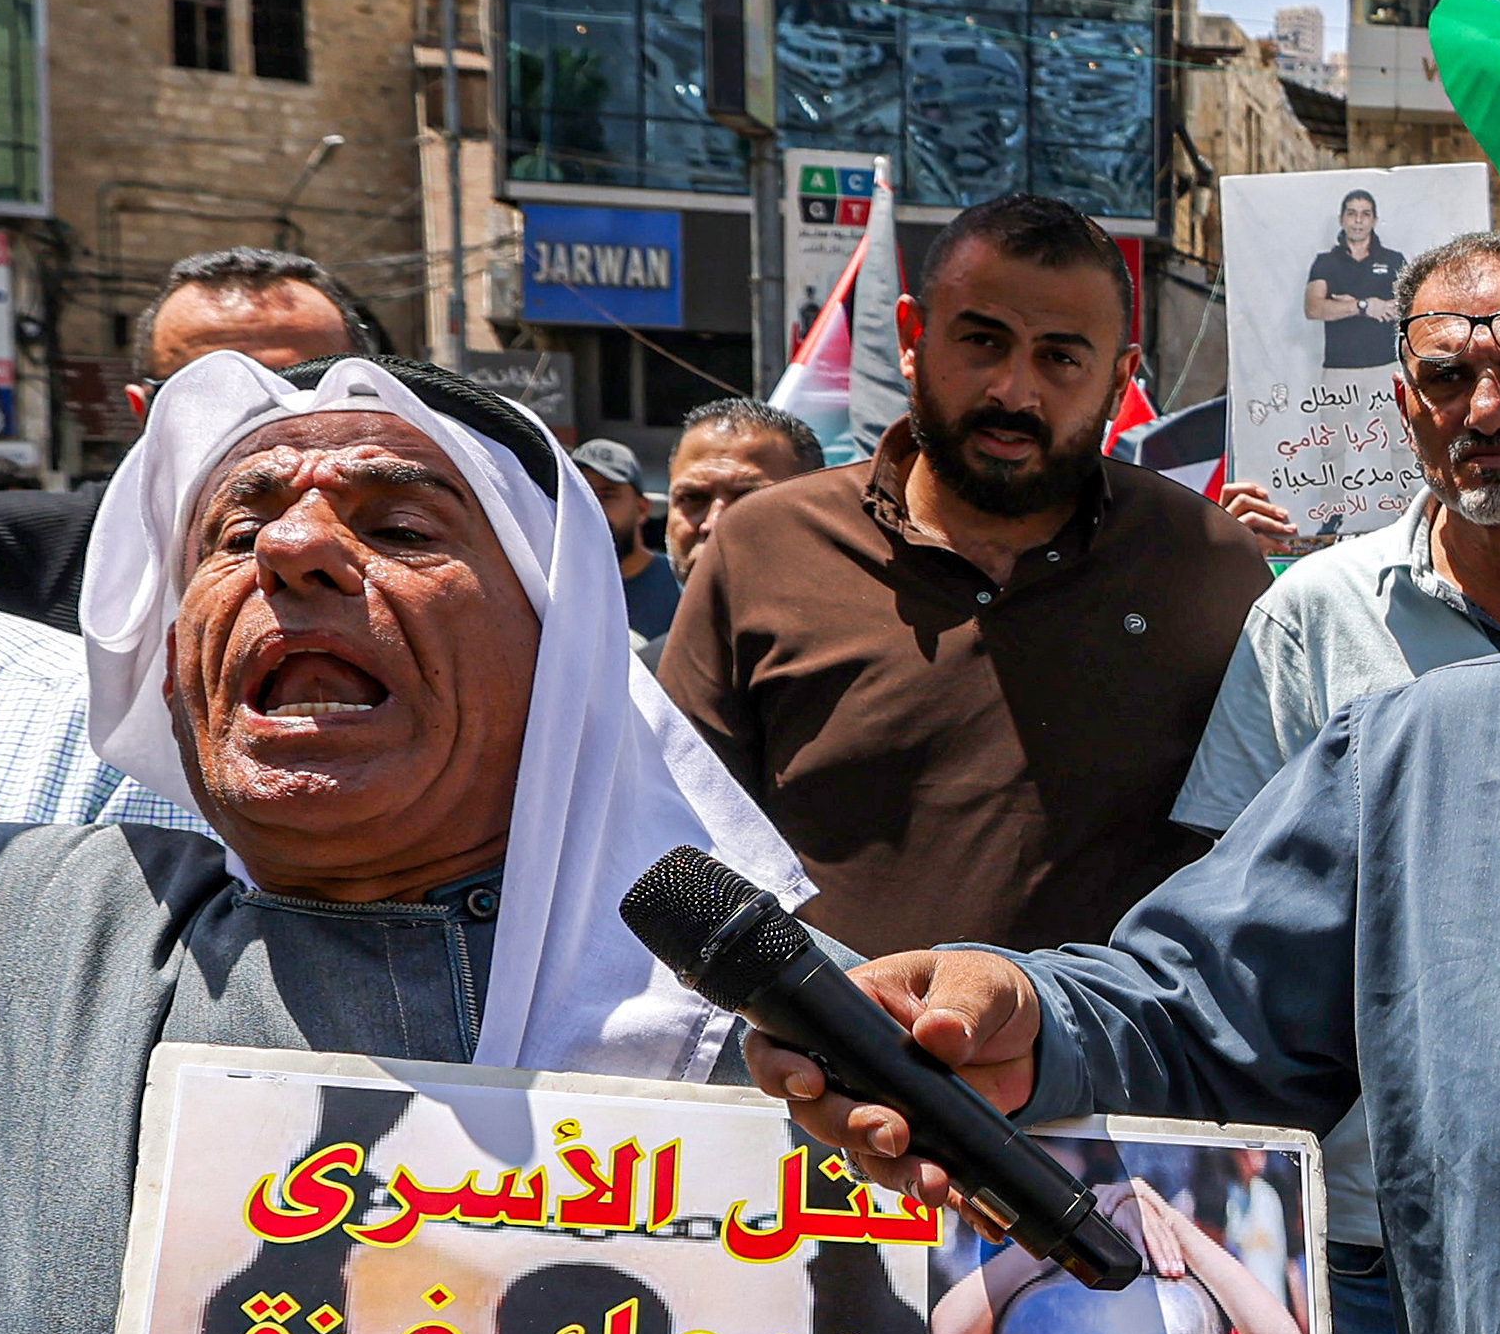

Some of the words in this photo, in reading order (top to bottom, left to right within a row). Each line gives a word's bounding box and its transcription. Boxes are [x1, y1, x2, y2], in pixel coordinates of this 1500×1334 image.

[533, 241, 671, 289] JARWAN
[1300, 384, 1361, 414] البطل
[1344, 418, 1389, 453] زكريا
[1271, 464, 1336, 495] الحياة
[1341, 467, 1394, 491] مدى
[242, 1119, 682, 1251] الأسرى
